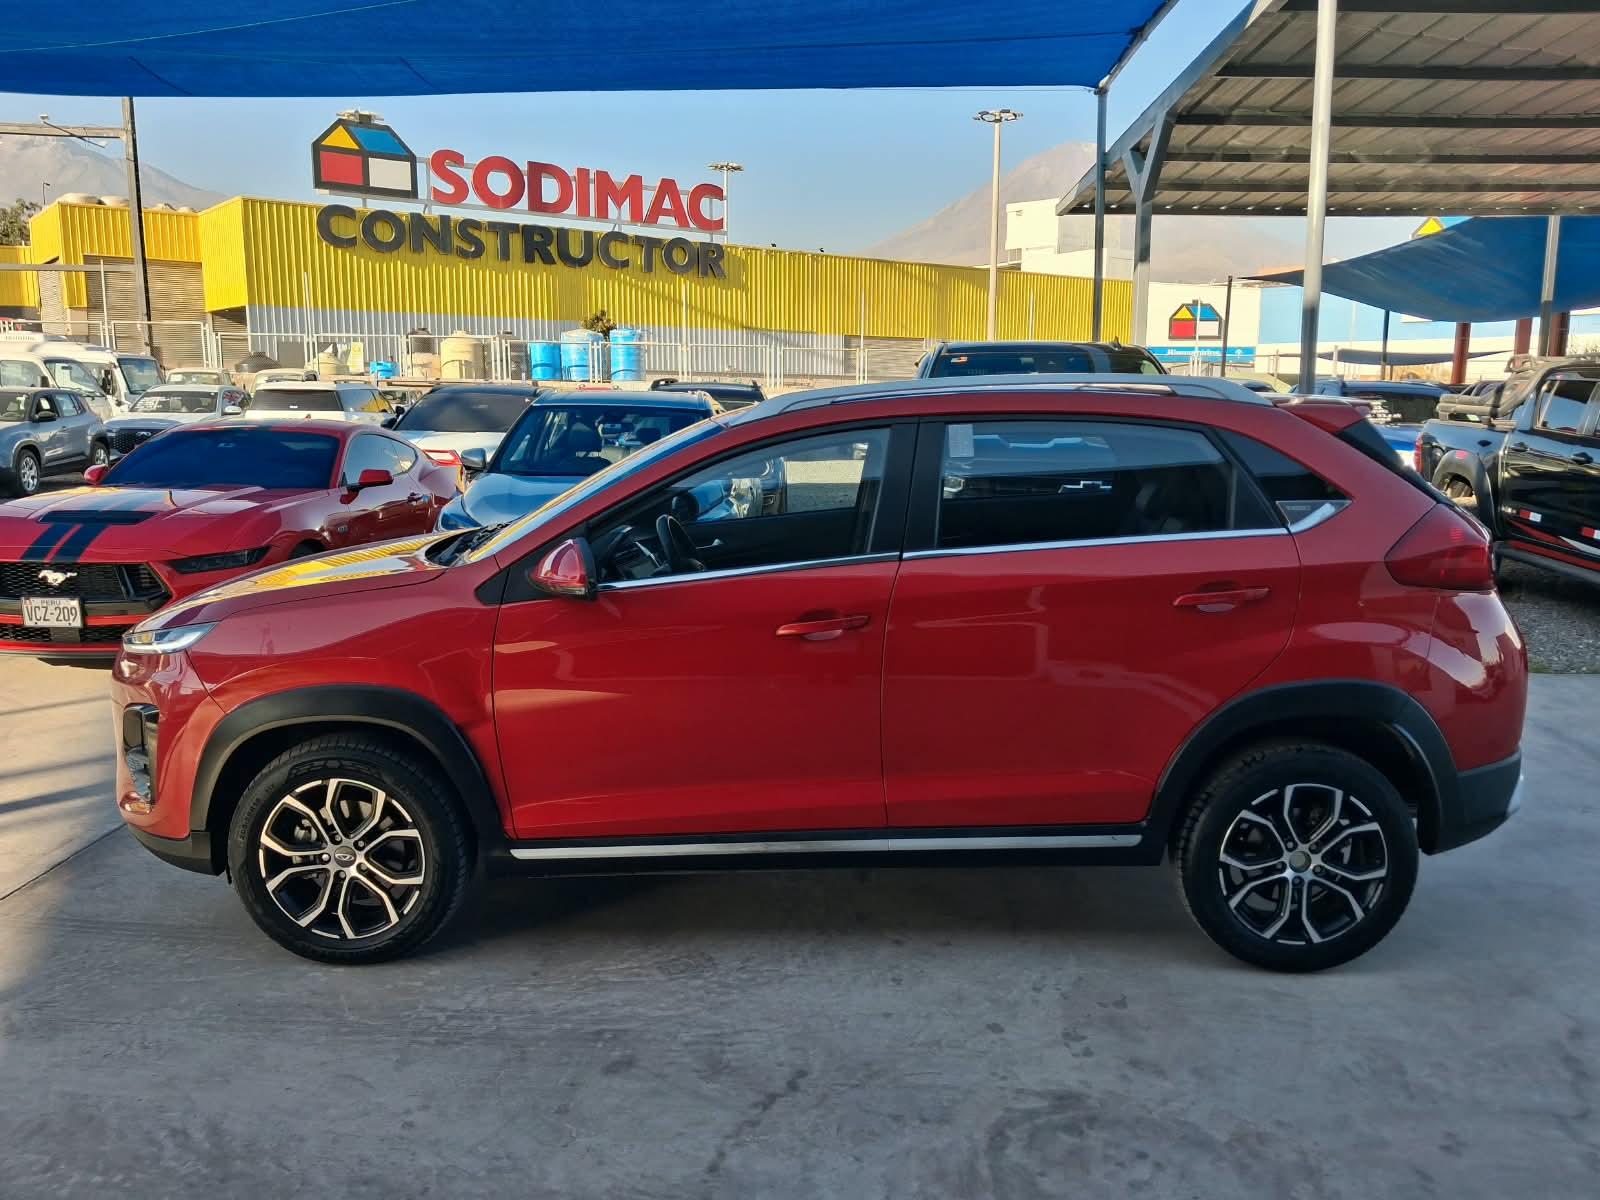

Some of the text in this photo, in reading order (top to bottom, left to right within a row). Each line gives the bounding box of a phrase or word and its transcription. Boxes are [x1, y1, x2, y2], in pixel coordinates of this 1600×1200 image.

[429, 149, 725, 231] SODIMAC
[316, 204, 726, 280] CONSTRUCTOR
[25, 605, 78, 622] VCZ-209
